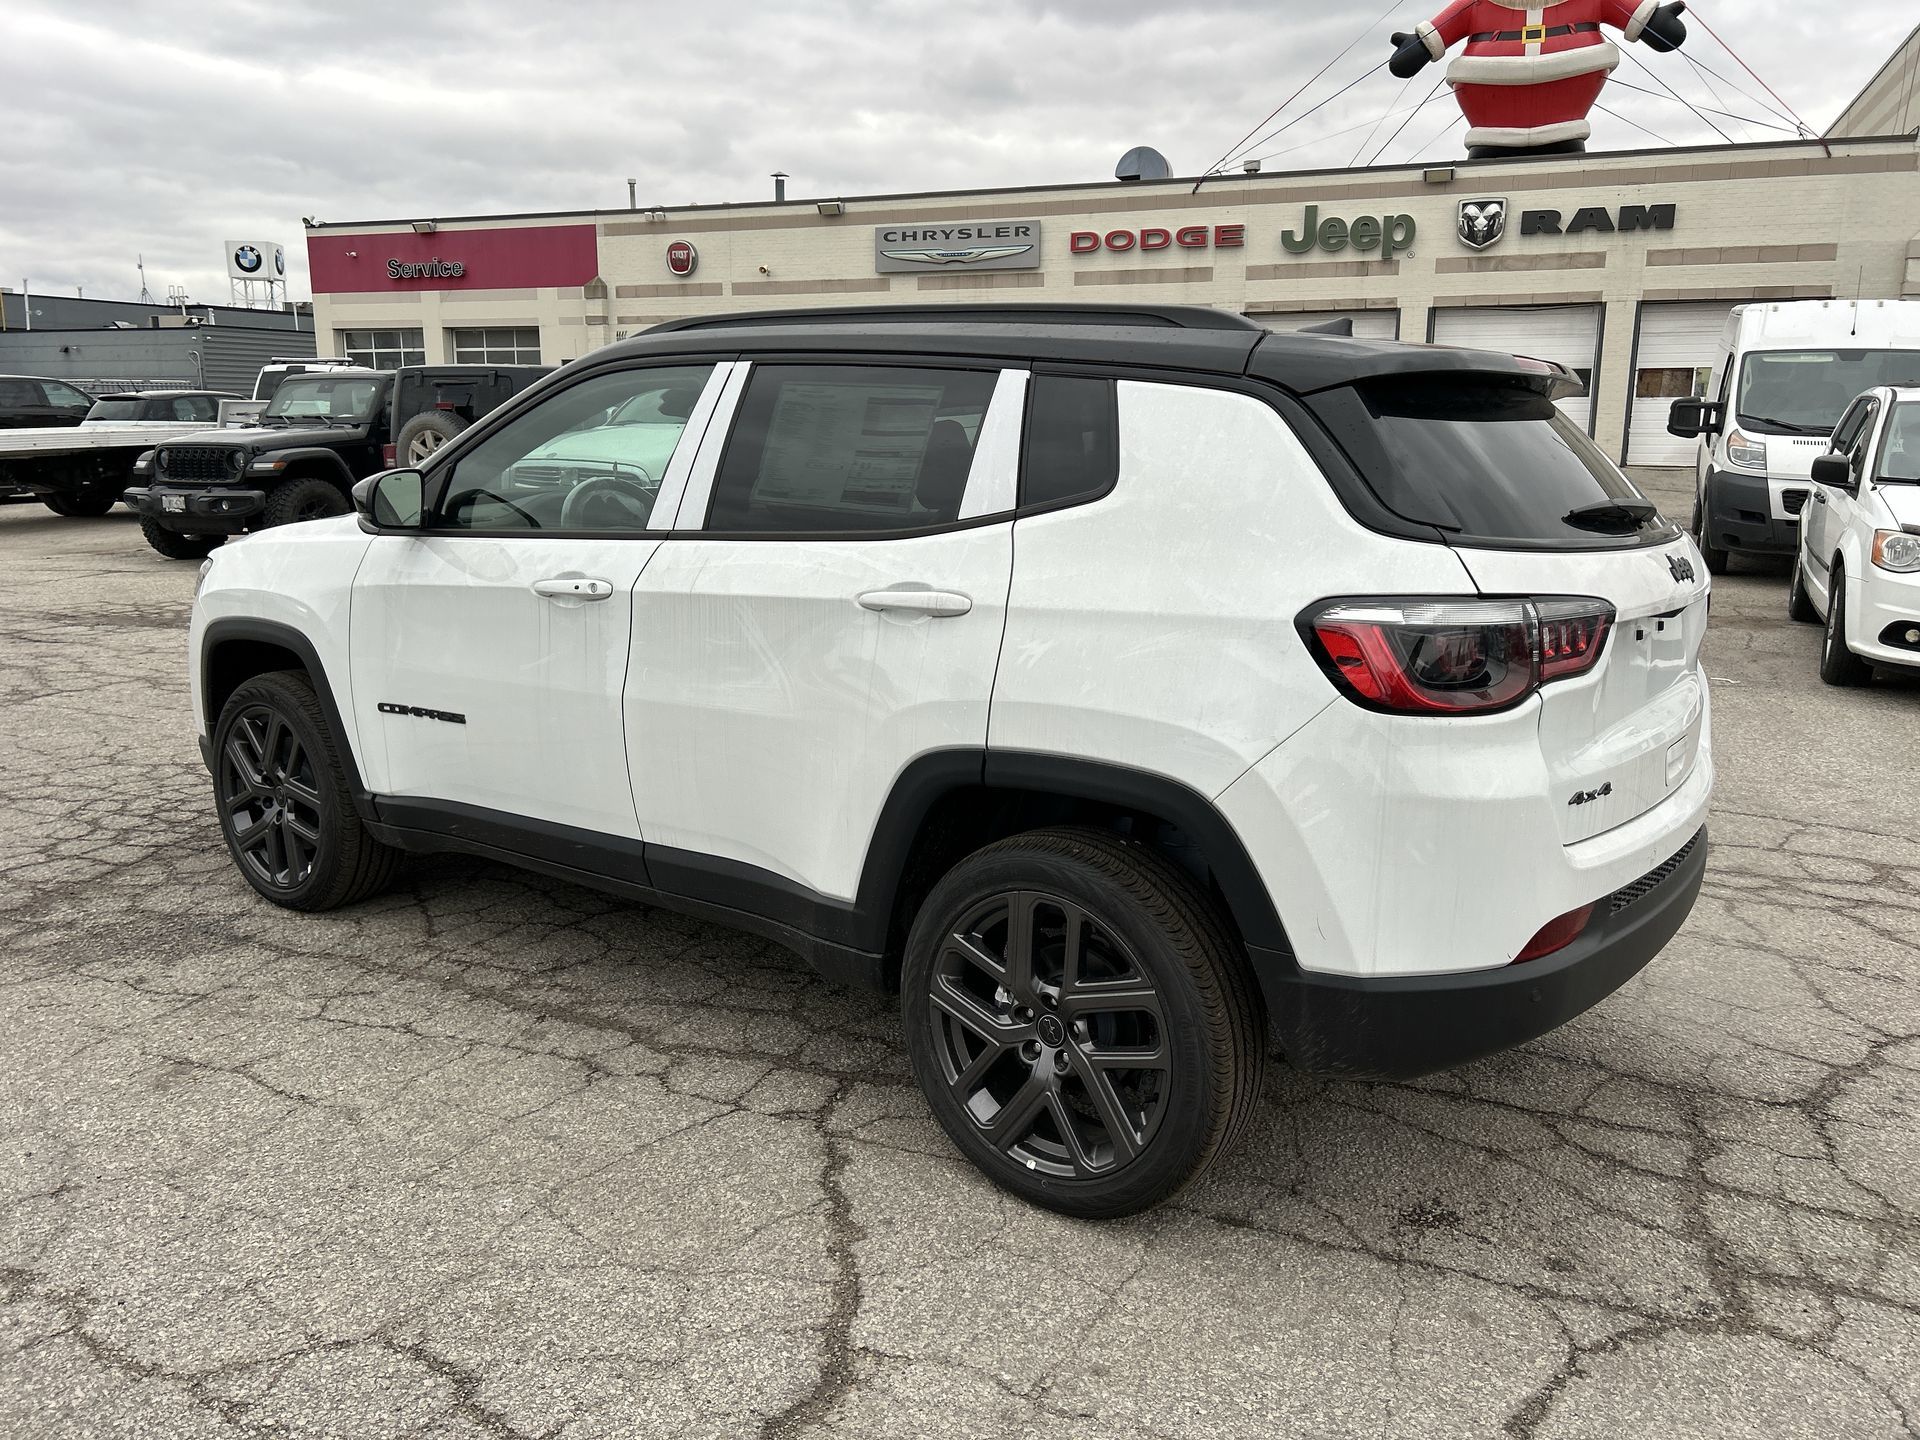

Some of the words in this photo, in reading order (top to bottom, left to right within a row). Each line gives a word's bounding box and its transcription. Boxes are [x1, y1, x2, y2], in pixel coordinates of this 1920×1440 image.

[1281, 204, 1416, 260] Jeep
[1520, 203, 1677, 235] RAM
[883, 226, 1031, 243] CHRYSLER
[1070, 224, 1245, 254] DODGE
[386, 257, 464, 279] Service
[377, 702, 467, 725] COMPASS
